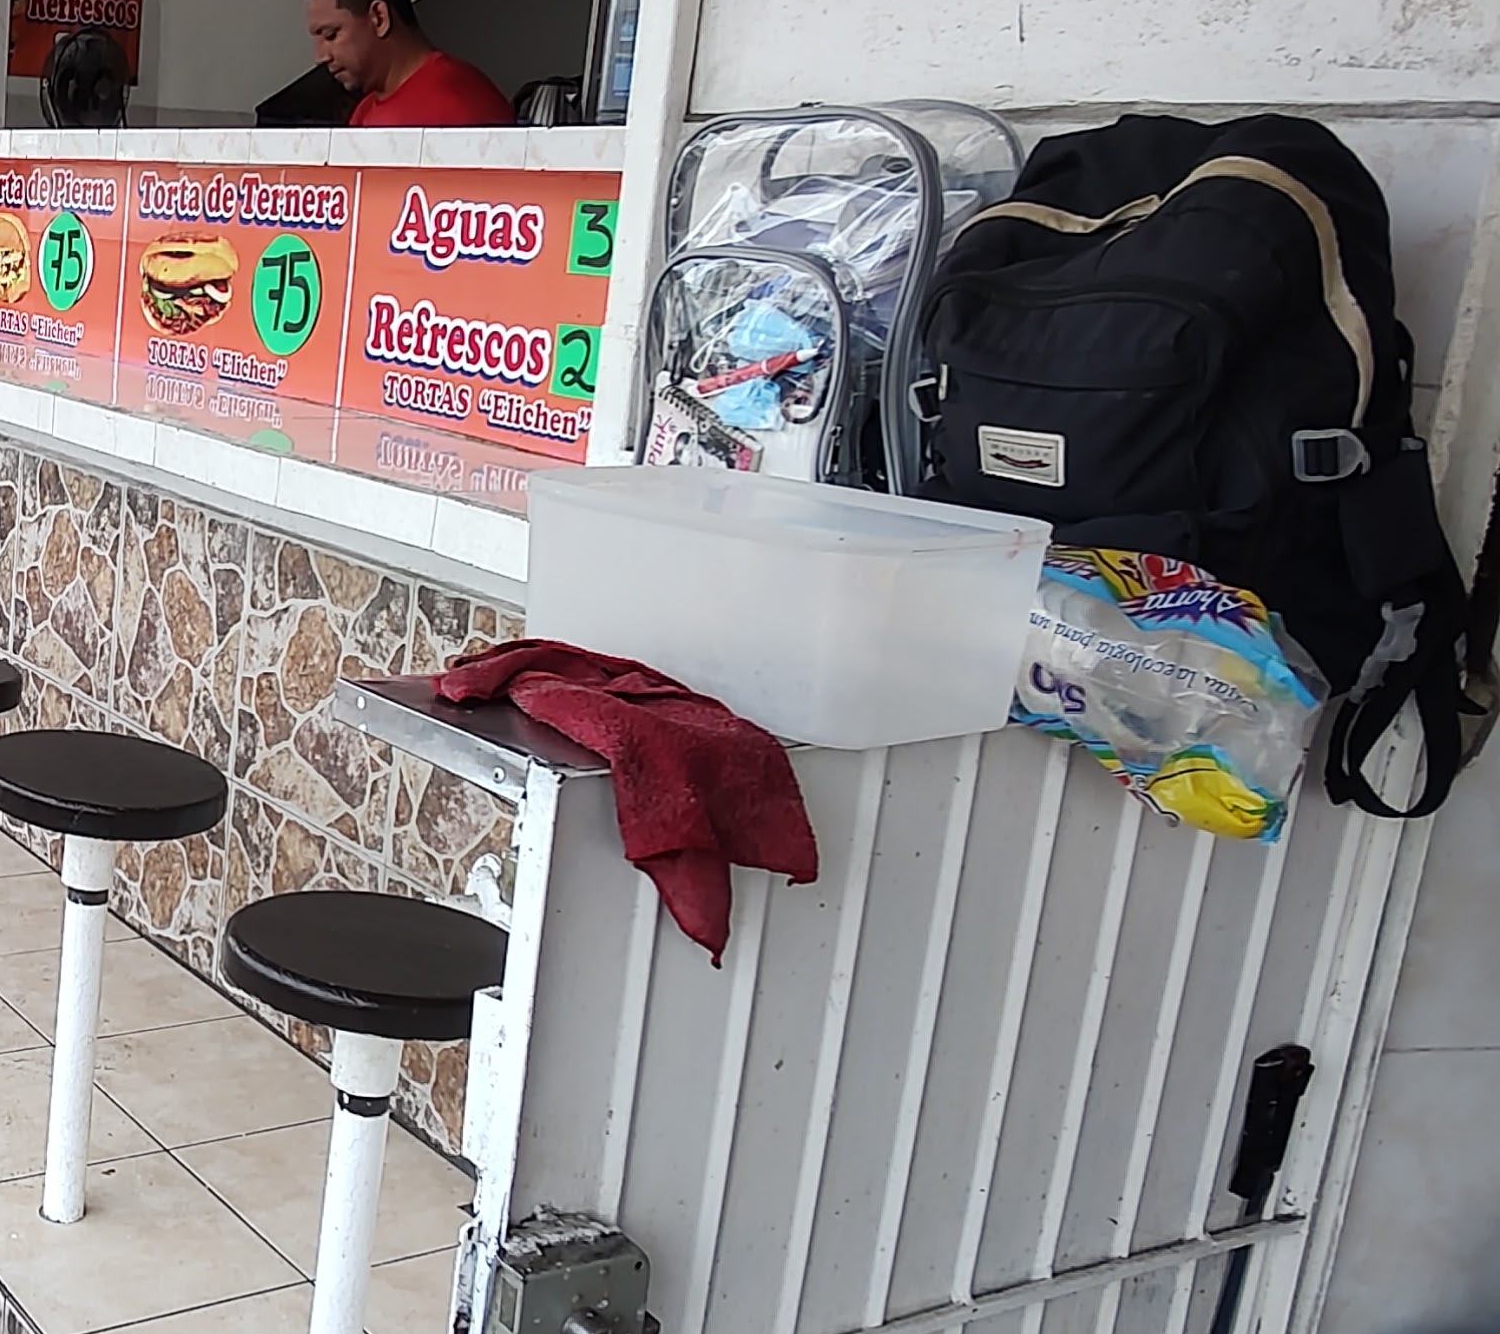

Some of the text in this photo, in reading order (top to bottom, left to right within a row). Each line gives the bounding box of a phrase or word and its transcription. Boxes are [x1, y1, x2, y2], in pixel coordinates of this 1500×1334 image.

[26, 168, 50, 208] de
[52, 169, 117, 212] Pierna
[140, 172, 348, 227] Torta de Ternera
[392, 186, 544, 266] Aguas
[49, 229, 83, 291] 75
[262, 251, 311, 333] 75
[32, 315, 84, 346] “Elichen”
[368, 295, 551, 383] Refrescos
[149, 337, 288, 387] TORTAS “Elichen”
[384, 373, 595, 442] TORTAS “Elichen”
[1054, 622, 1095, 650] para
